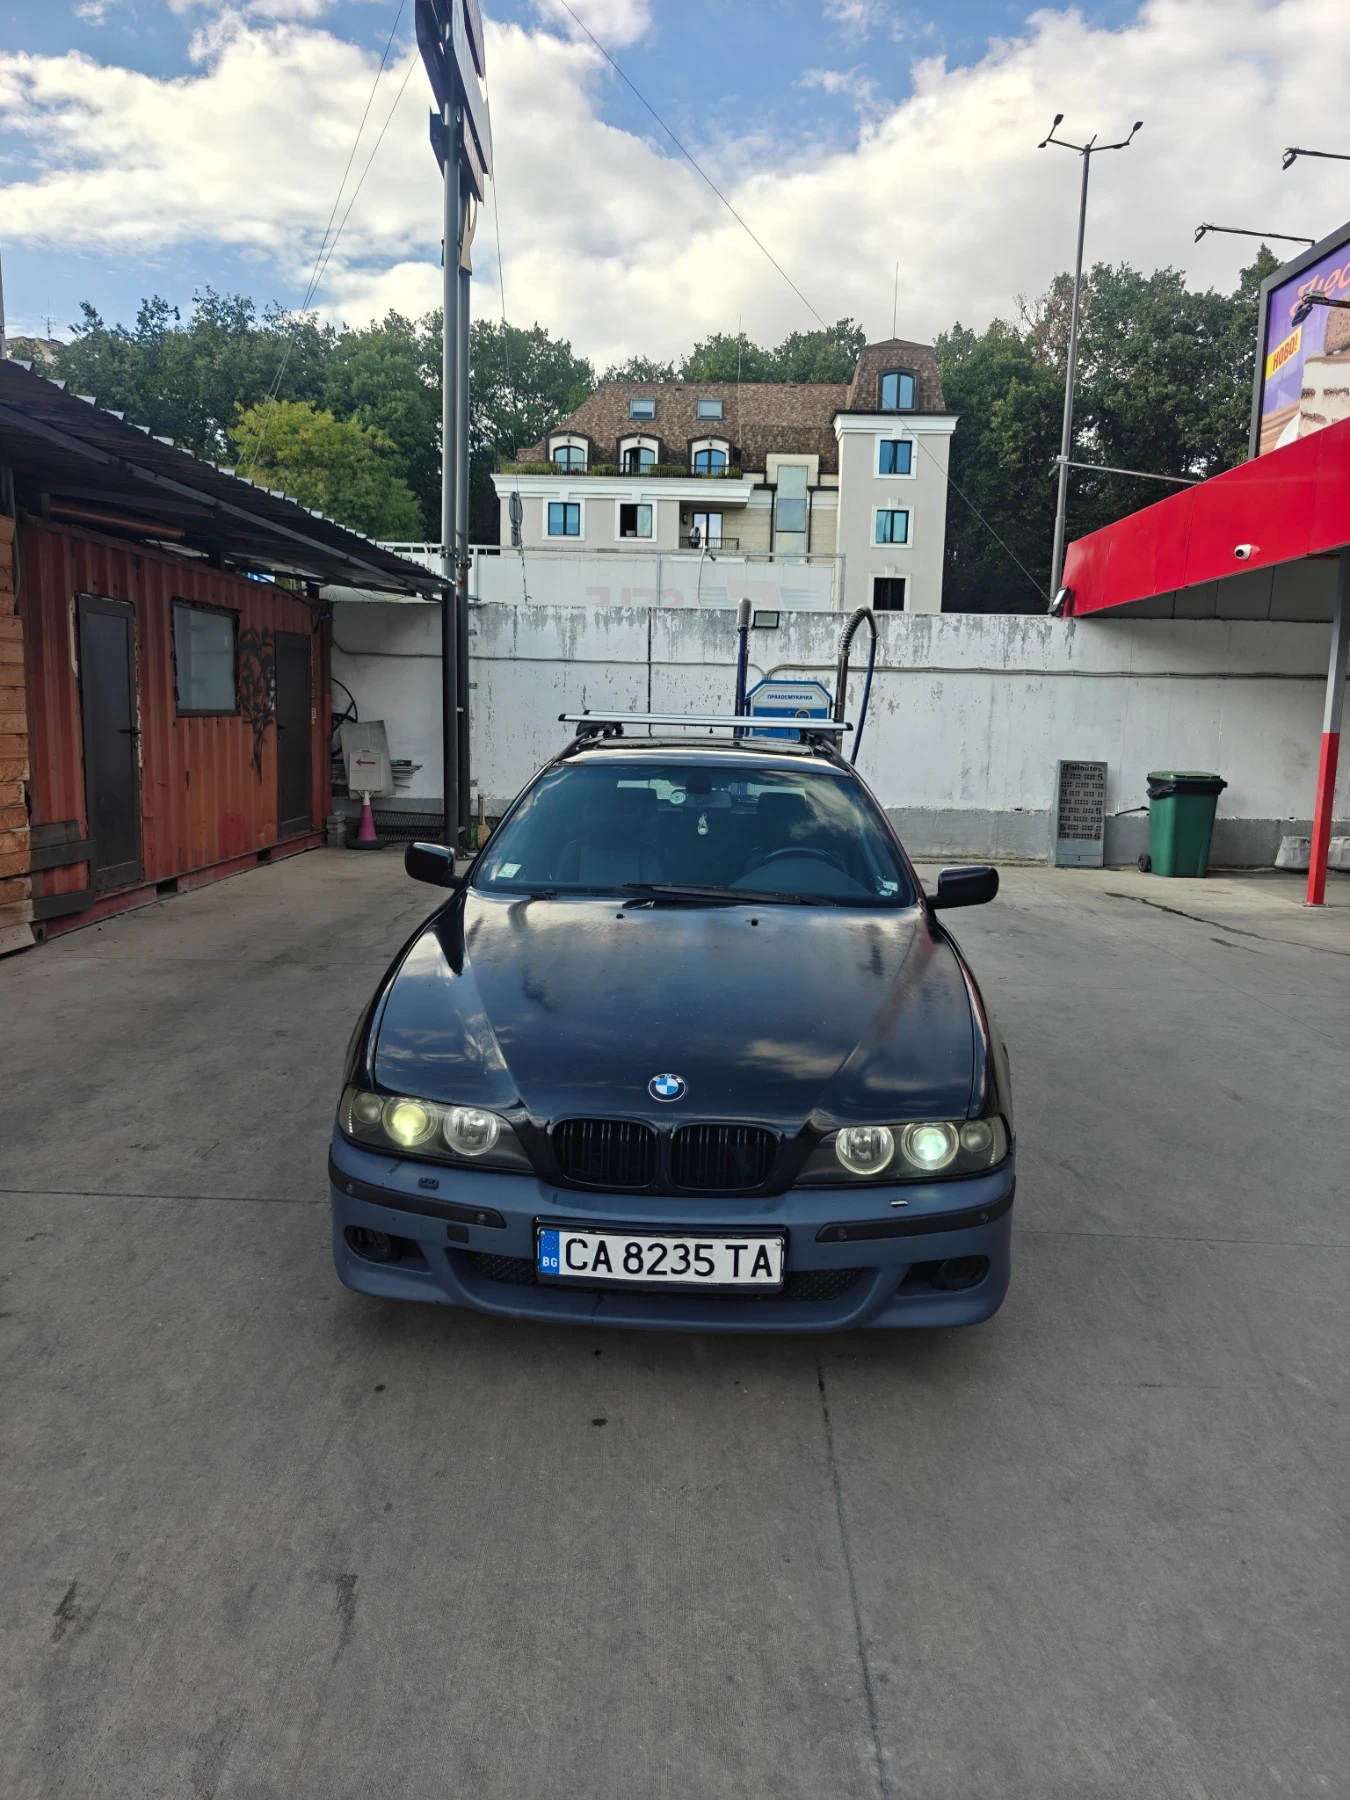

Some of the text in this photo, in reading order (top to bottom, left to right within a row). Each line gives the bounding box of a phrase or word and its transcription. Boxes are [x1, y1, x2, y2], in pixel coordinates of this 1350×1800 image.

[1272, 333, 1298, 371] НОВО!
[542, 1255, 559, 1268] BG
[565, 1238, 774, 1278] CA 8235 TA
